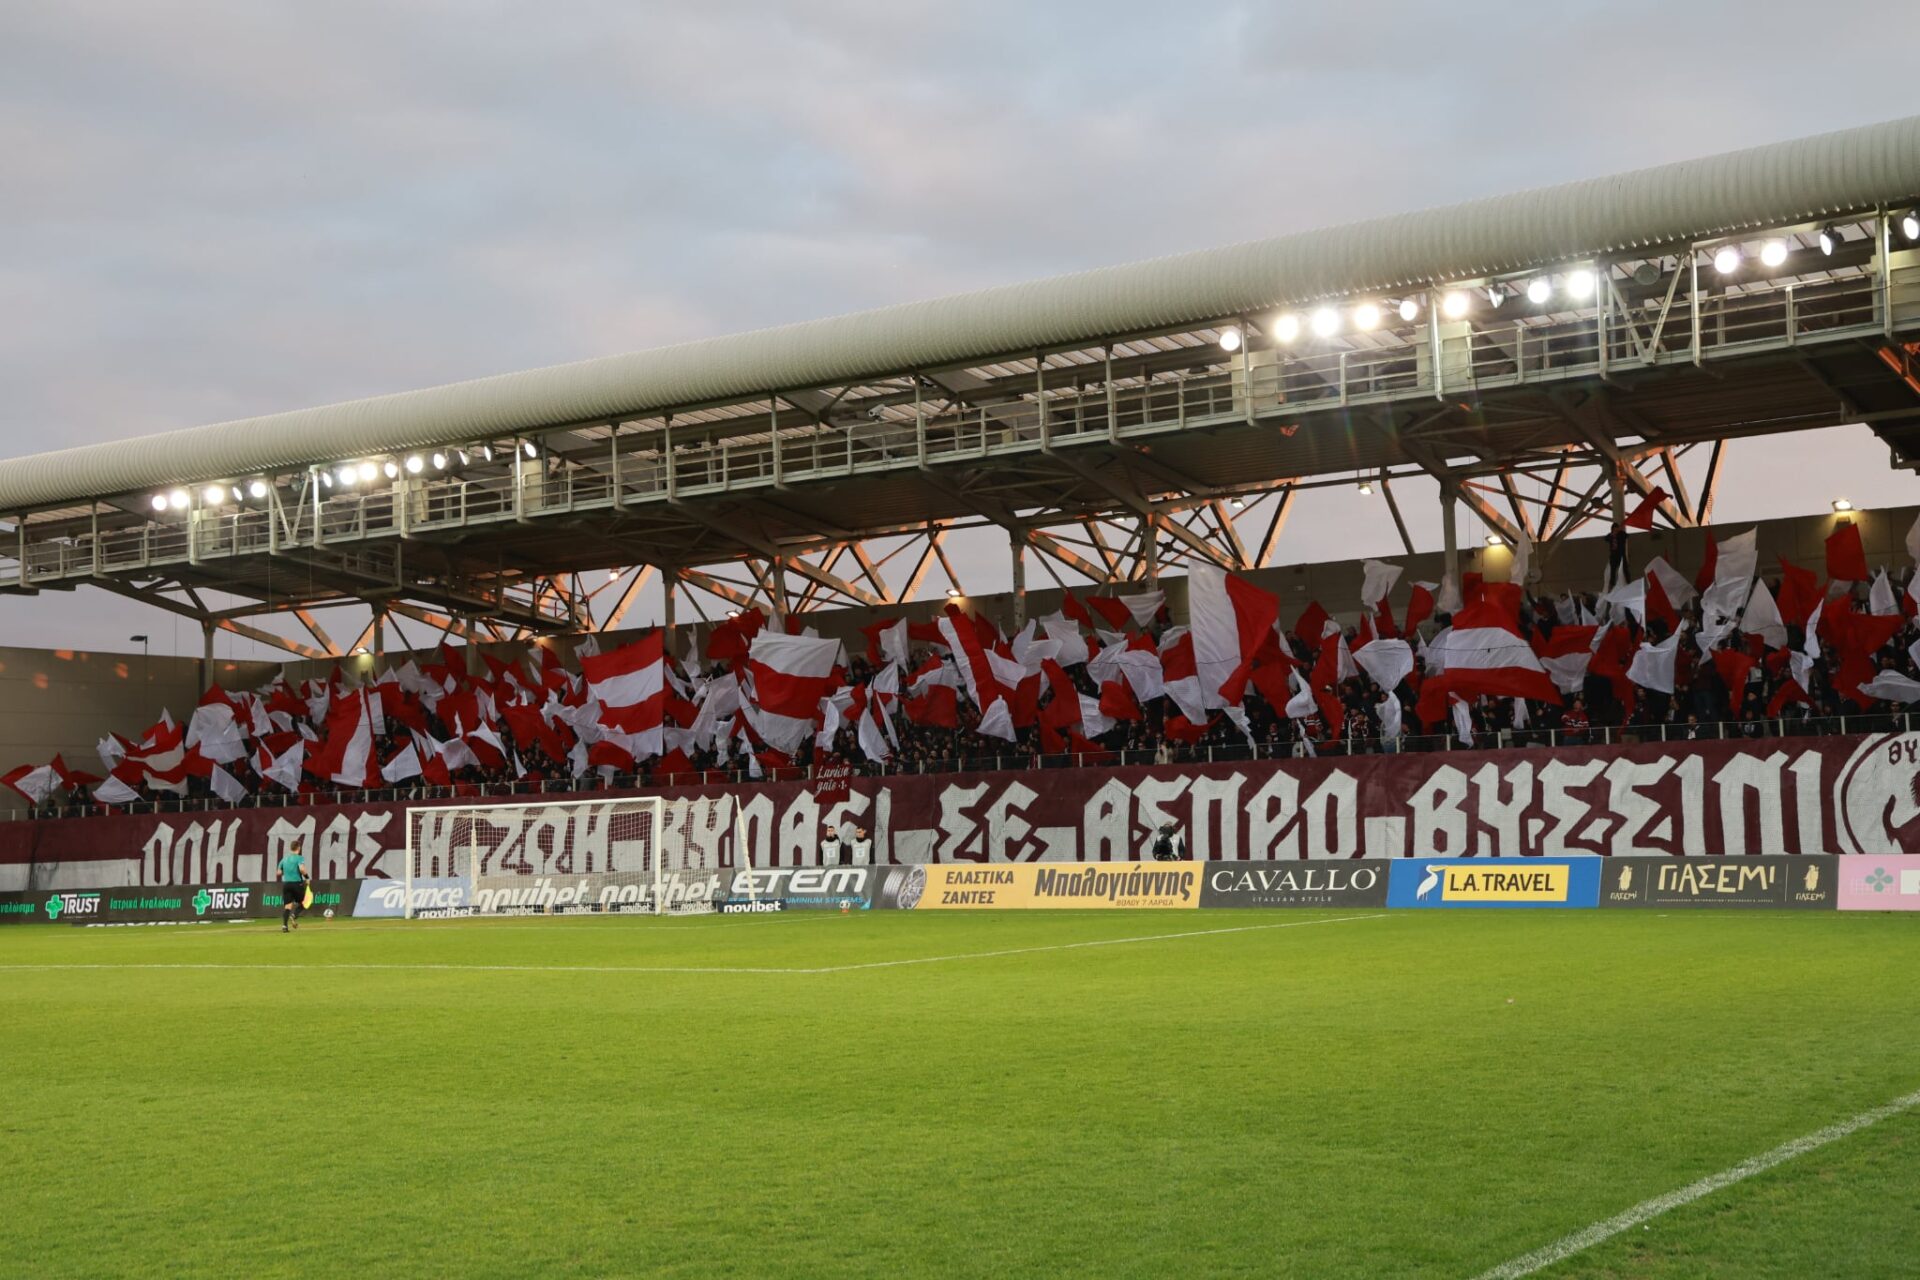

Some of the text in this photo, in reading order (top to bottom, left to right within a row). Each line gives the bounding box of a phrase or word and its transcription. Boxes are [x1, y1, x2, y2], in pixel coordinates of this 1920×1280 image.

[267, 811, 392, 882] ΜΑΣ
[419, 809, 458, 878] Η
[938, 780, 1039, 863] ΣΕ
[1084, 768, 1358, 862] ΑΣΠΡΟ
[1407, 750, 1824, 857] ΒΥΣΣΙΝΙ
[731, 868, 867, 893] ETEM
[946, 871, 1014, 885] ΕΛΑΣΤΙΚΑ
[1034, 864, 1194, 901] Μπαλογιάννης
[1211, 868, 1377, 892] CAVALLO
[1450, 874, 1554, 891] L.A. TRAVEL
[60, 893, 100, 914] TRUST
[208, 888, 249, 909] TRUST
[476, 878, 588, 913] novibet
[942, 890, 996, 904] ΖΑΝΤΕΣ
[418, 905, 475, 918] novibet
[724, 901, 781, 913] novibet
